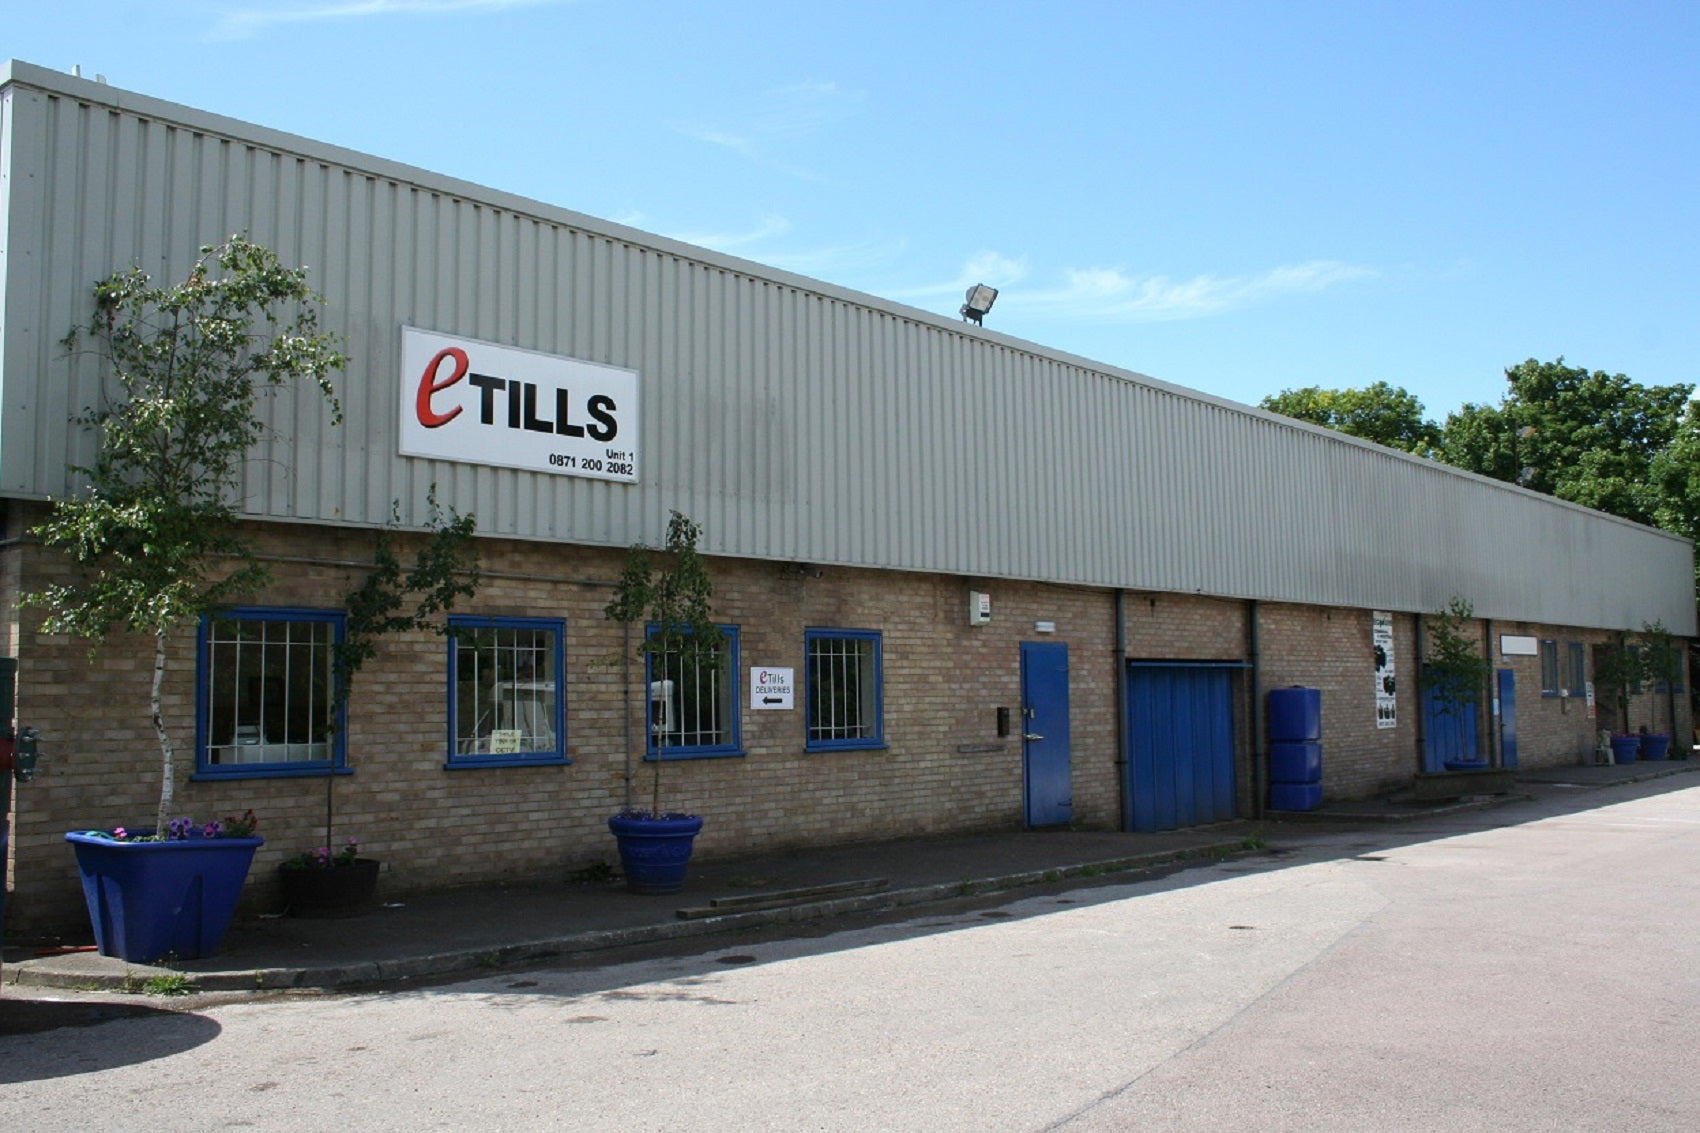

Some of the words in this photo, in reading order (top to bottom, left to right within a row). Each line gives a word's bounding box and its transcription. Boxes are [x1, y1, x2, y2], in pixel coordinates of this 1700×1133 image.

[606, 449, 625, 461] Unit
[629, 452, 634, 462] 1
[549, 453, 576, 468] 0871
[582, 458, 603, 471] 200
[607, 462, 633, 475] 2082
[756, 685, 790, 694] DELIVERIES
